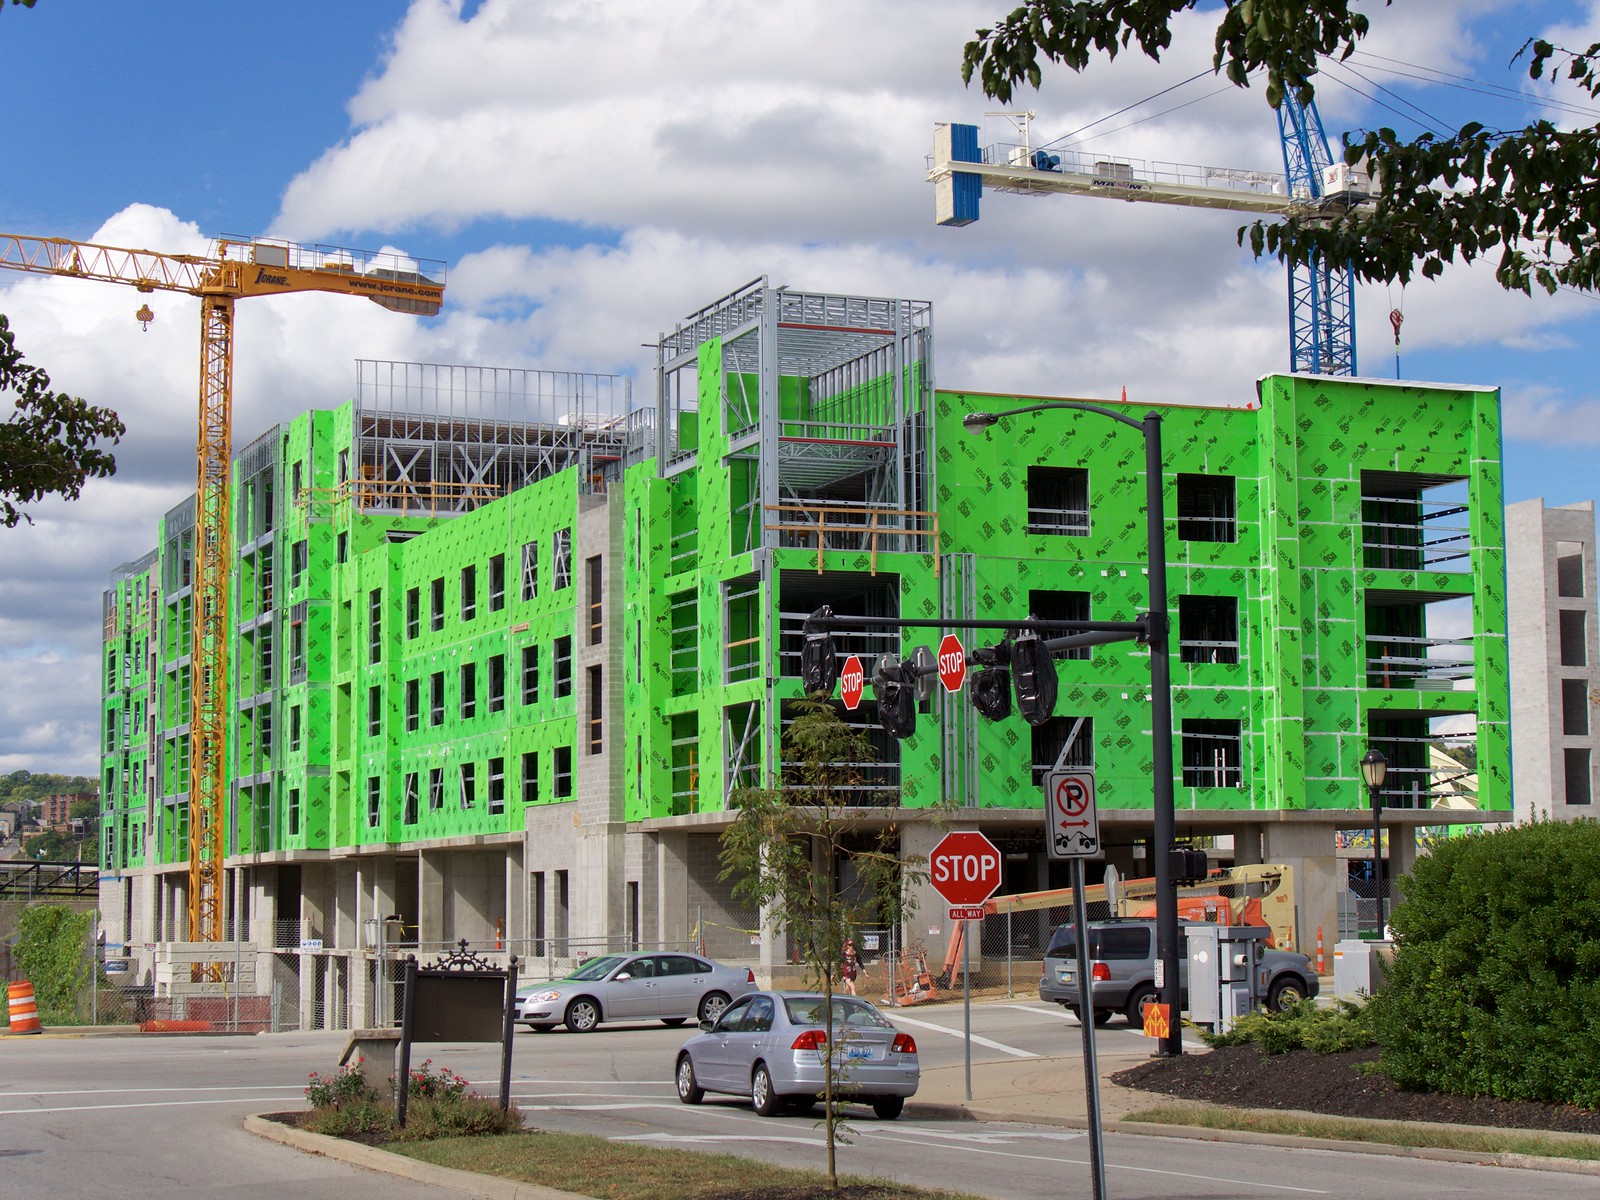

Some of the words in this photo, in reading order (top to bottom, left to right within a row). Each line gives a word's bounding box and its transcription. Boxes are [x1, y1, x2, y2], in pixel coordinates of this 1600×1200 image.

[349, 280, 440, 298] www.jcrane.com
[940, 652, 962, 675] STOP
[842, 676, 862, 694] STOP
[1066, 784, 1082, 809] P
[934, 854, 996, 882] STOP
[967, 910, 981, 918] WAY
